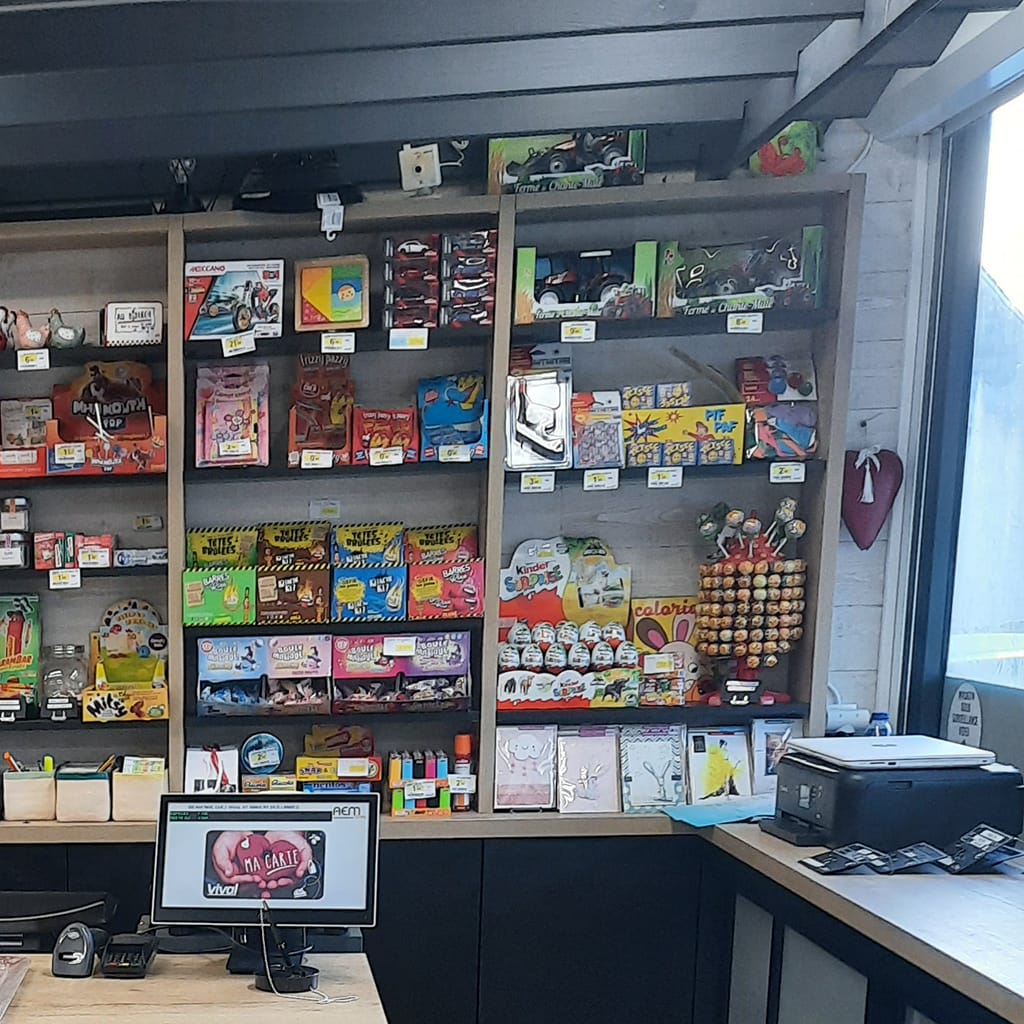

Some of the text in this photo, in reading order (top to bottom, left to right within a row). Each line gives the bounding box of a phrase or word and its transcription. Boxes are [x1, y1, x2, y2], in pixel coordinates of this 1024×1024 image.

[705, 409, 726, 421] PIF
[715, 421, 738, 433] PAF
[515, 561, 549, 575] Kinder
[333, 806, 361, 816] AEM
[244, 850, 300, 873] MA CARTE
